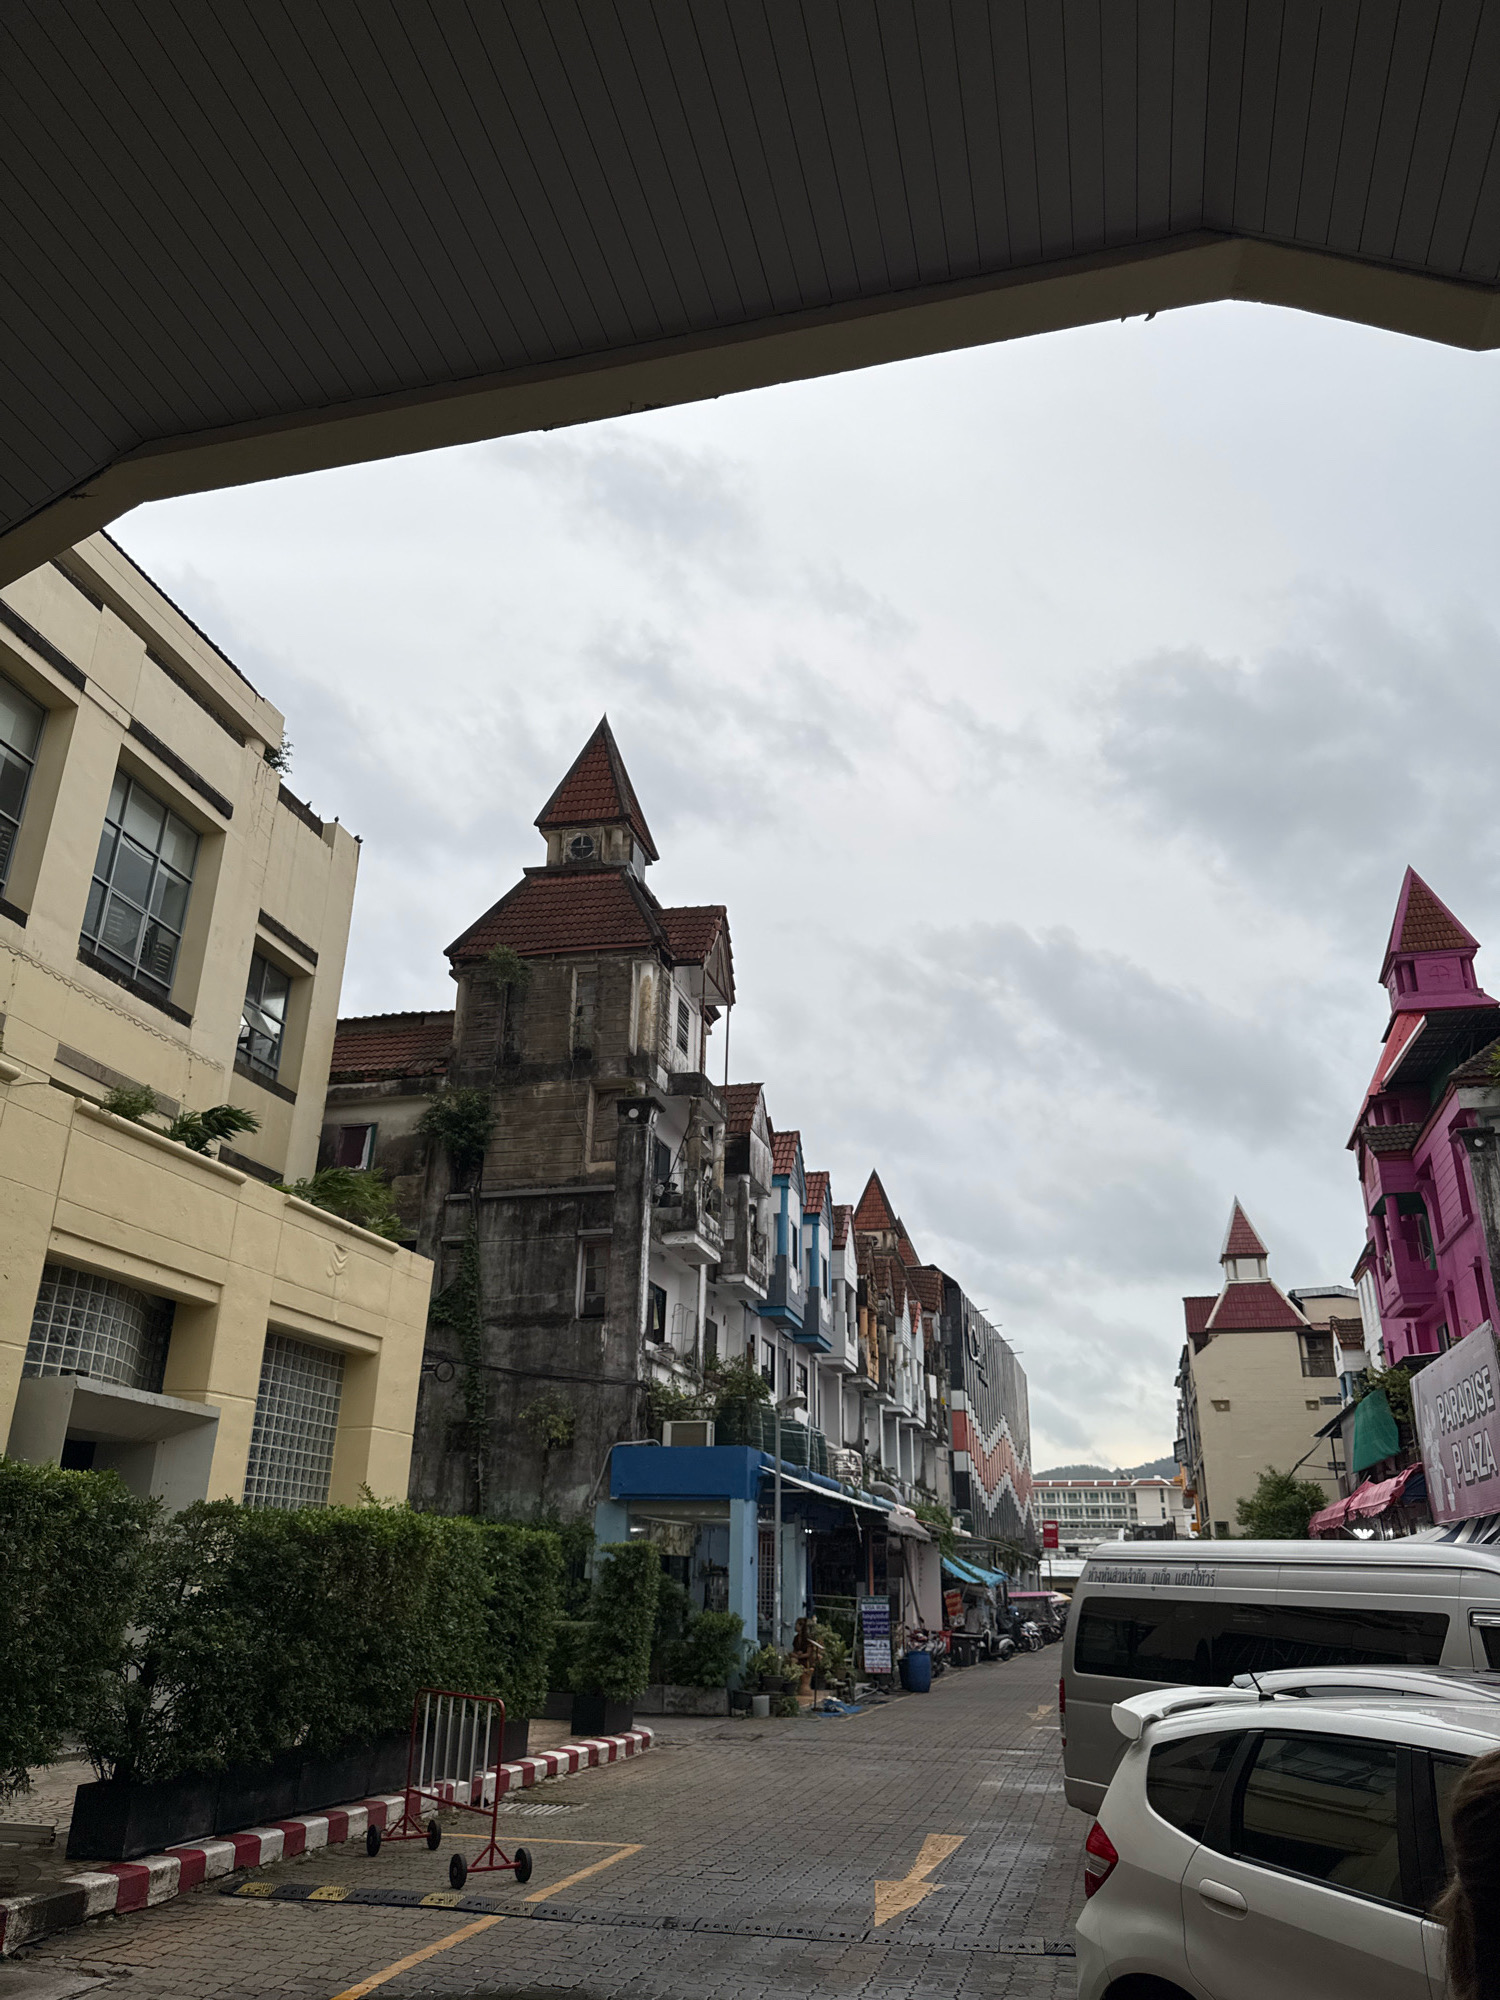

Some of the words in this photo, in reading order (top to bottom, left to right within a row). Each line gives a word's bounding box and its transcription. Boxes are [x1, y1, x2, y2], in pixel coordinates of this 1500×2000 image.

[1436, 1365, 1496, 1435] PARADISE
[1451, 1428, 1499, 1488] PLAZA
[1088, 1567, 1147, 1590] ห้างหุ้นส่วนจำกัด
[1151, 1568, 1171, 1591] ภูเก็ต
